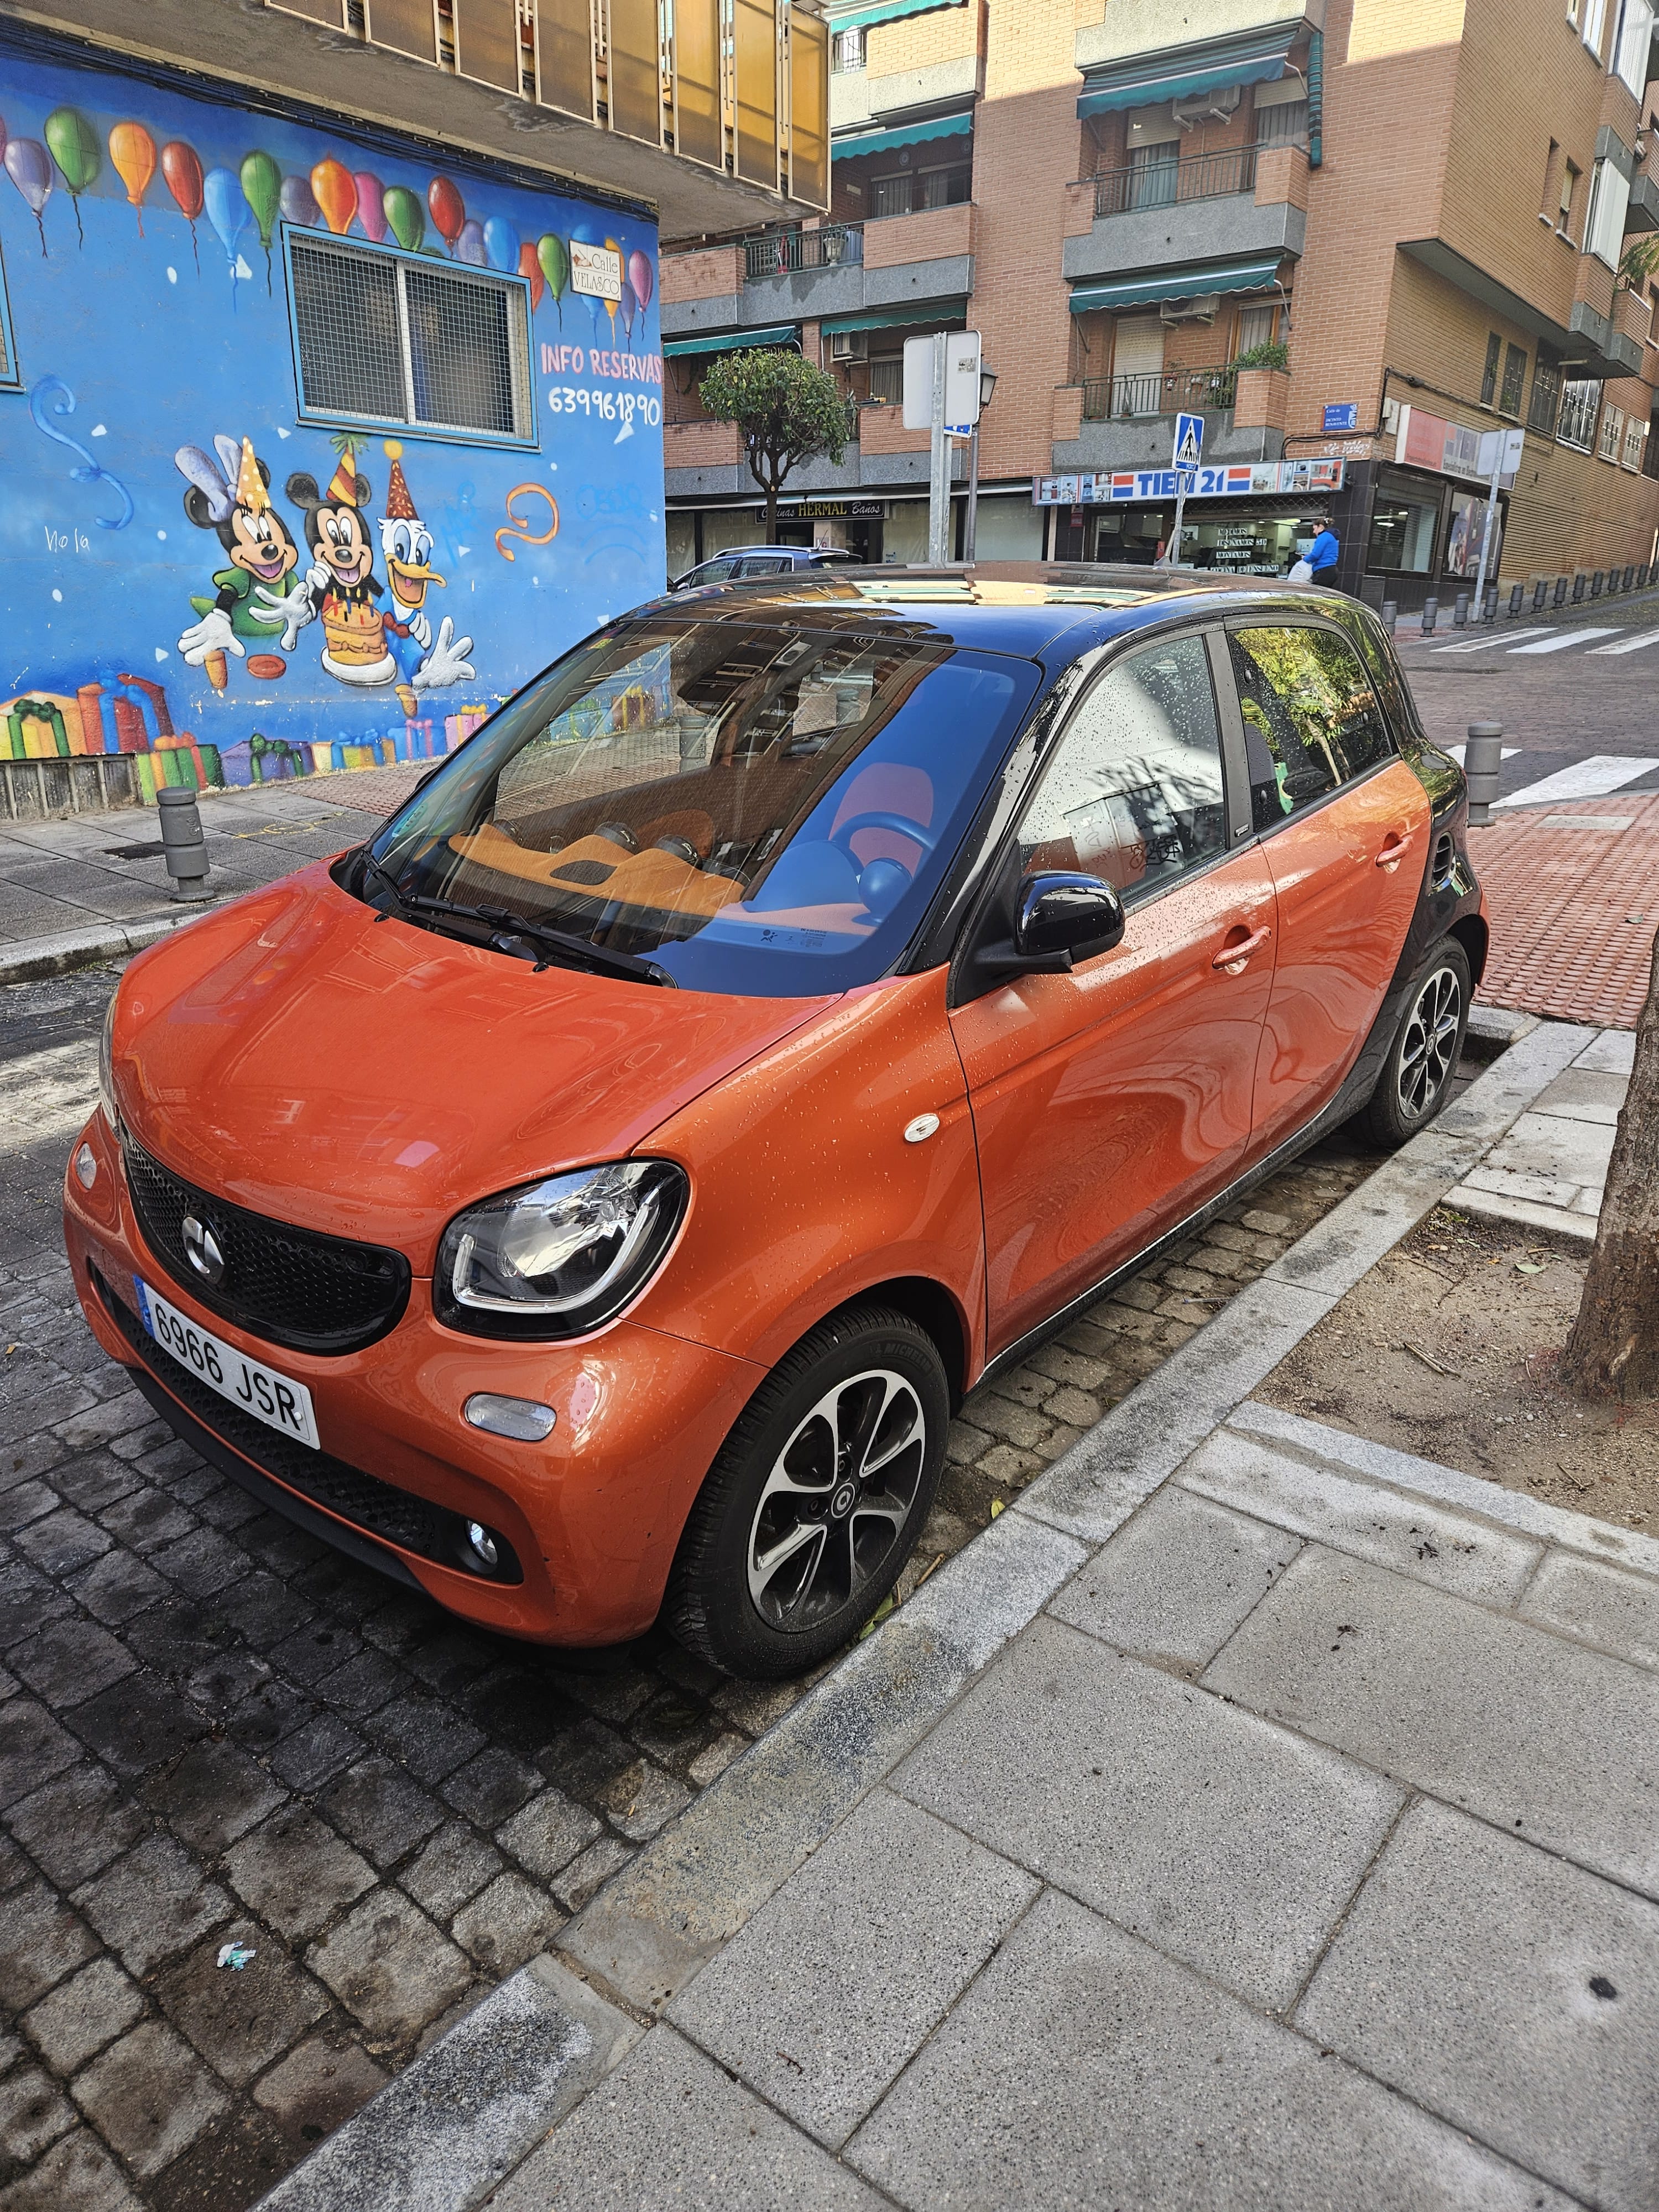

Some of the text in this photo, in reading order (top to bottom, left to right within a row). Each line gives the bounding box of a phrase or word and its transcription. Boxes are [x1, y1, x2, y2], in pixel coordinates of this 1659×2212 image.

[592, 253, 618, 273] Calle
[573, 271, 619, 295] VELASCO
[540, 342, 662, 385] INFO RESERVAS
[548, 387, 661, 426] 639961890
[1201, 470, 1224, 493] 21
[798, 502, 847, 517] HERMAL
[852, 500, 881, 515] Baños
[155, 1303, 301, 1431] 6966 JSR
[883, 1343, 931, 1374] MICHELIN
